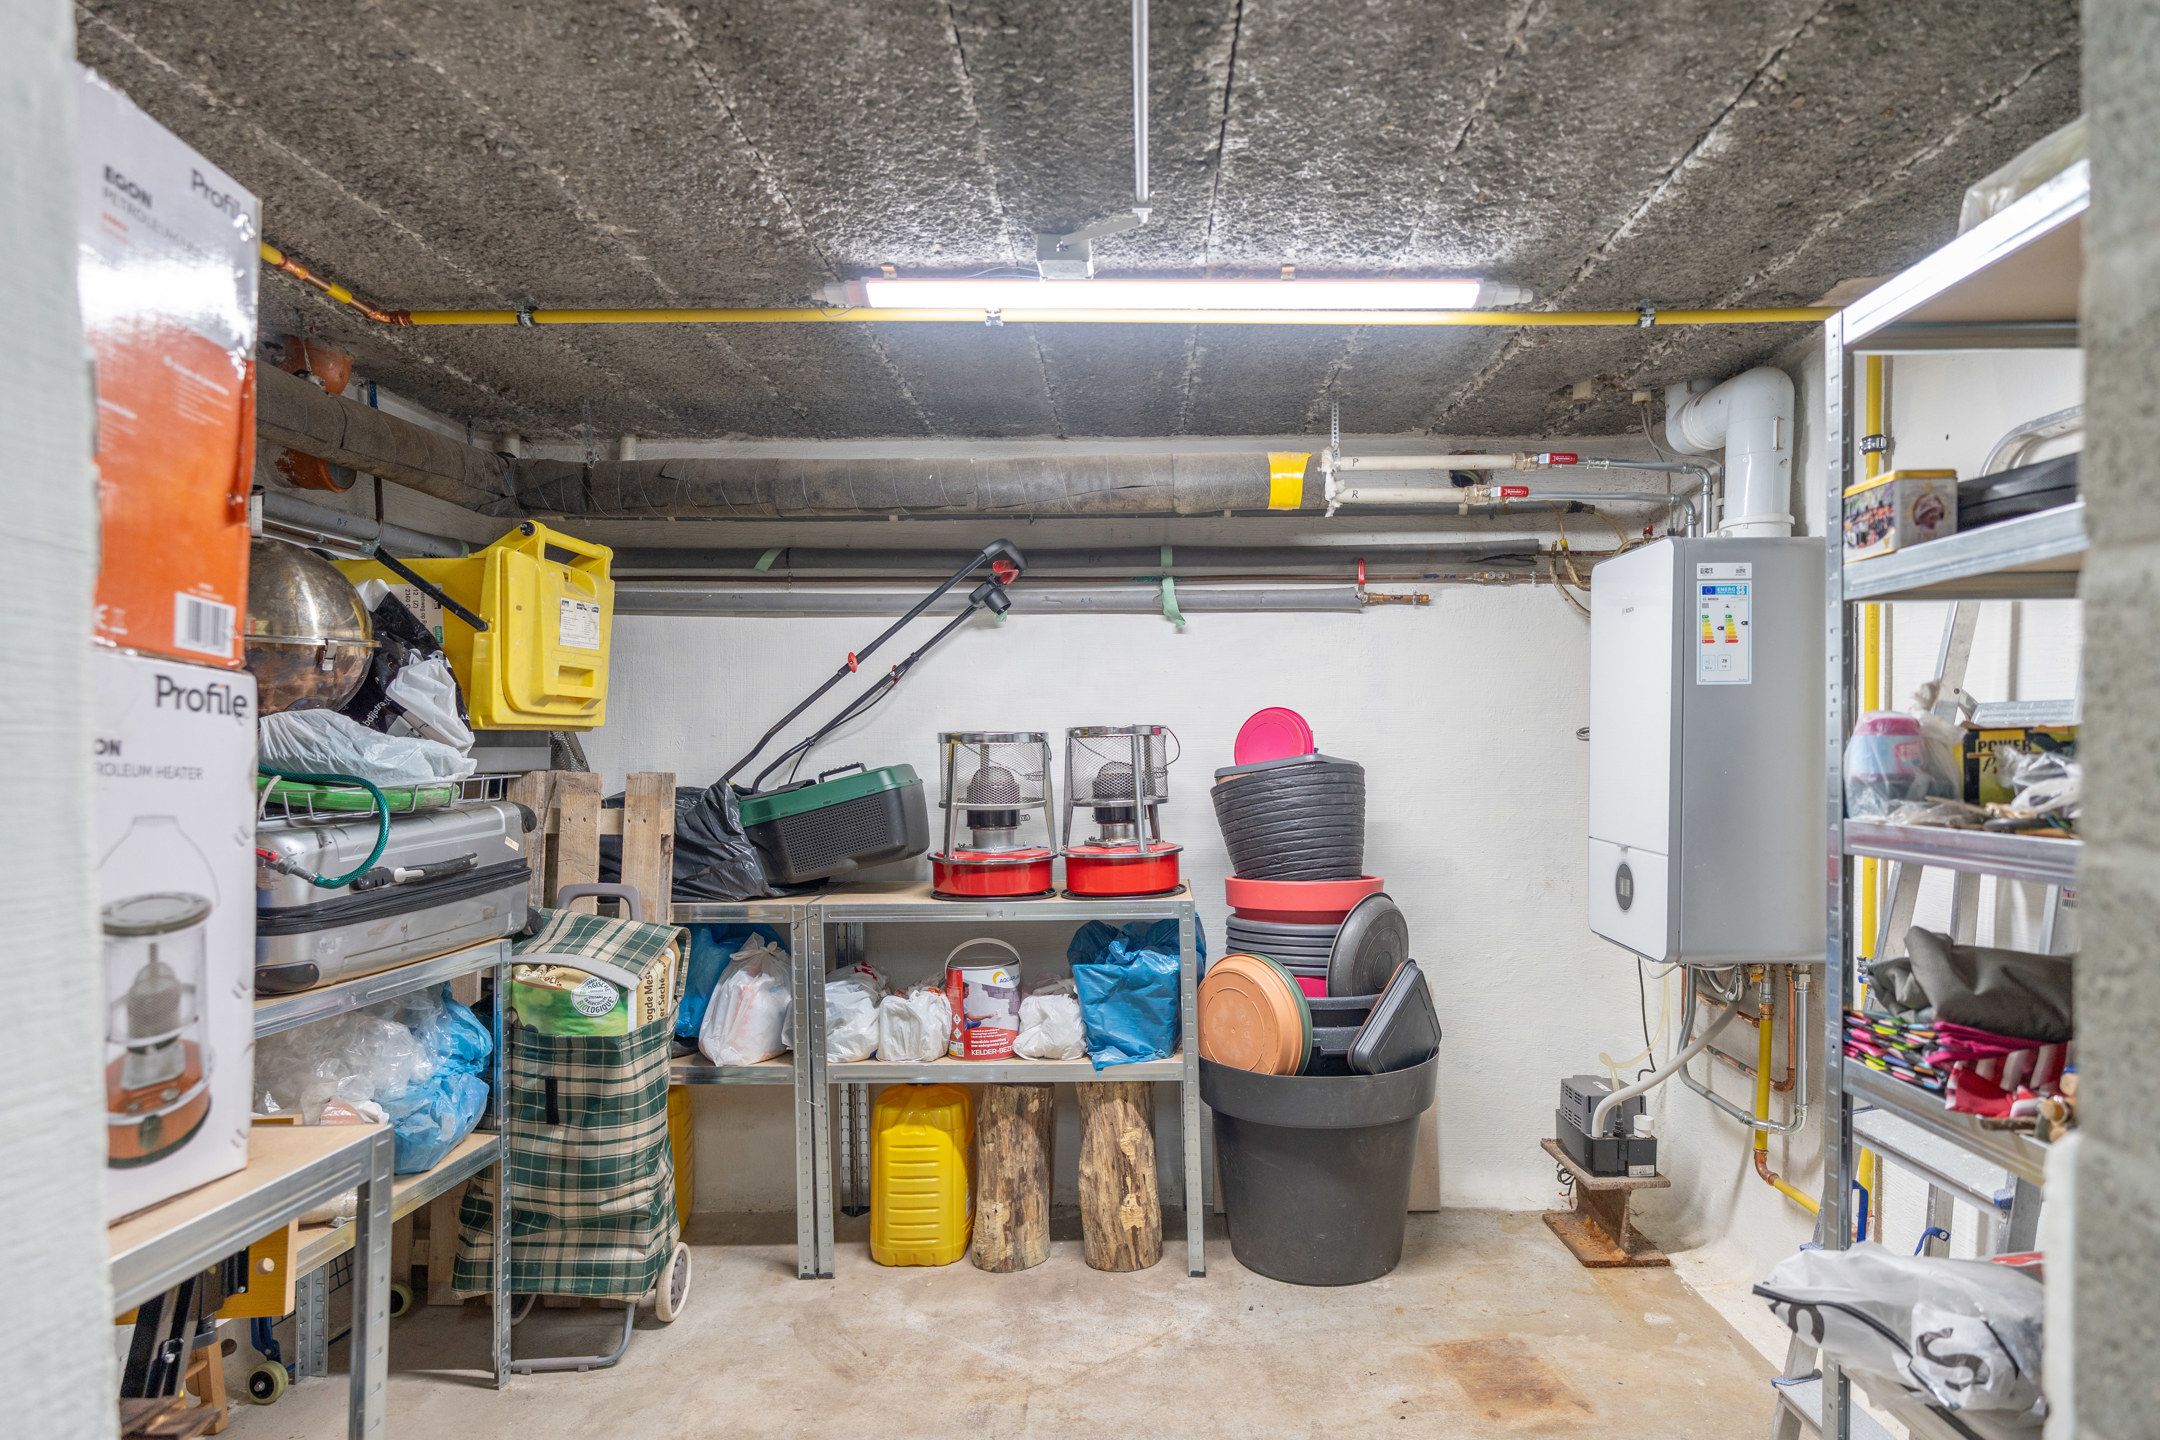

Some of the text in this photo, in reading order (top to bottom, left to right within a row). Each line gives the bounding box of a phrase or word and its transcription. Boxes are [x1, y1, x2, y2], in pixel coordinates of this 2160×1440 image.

[104, 165, 152, 208] EGON
[191, 167, 243, 219] Profil
[1352, 457, 1359, 468] P
[1351, 489, 1359, 499] R
[155, 675, 248, 719] Profile
[95, 738, 122, 756] ON
[155, 765, 204, 780] HEATER
